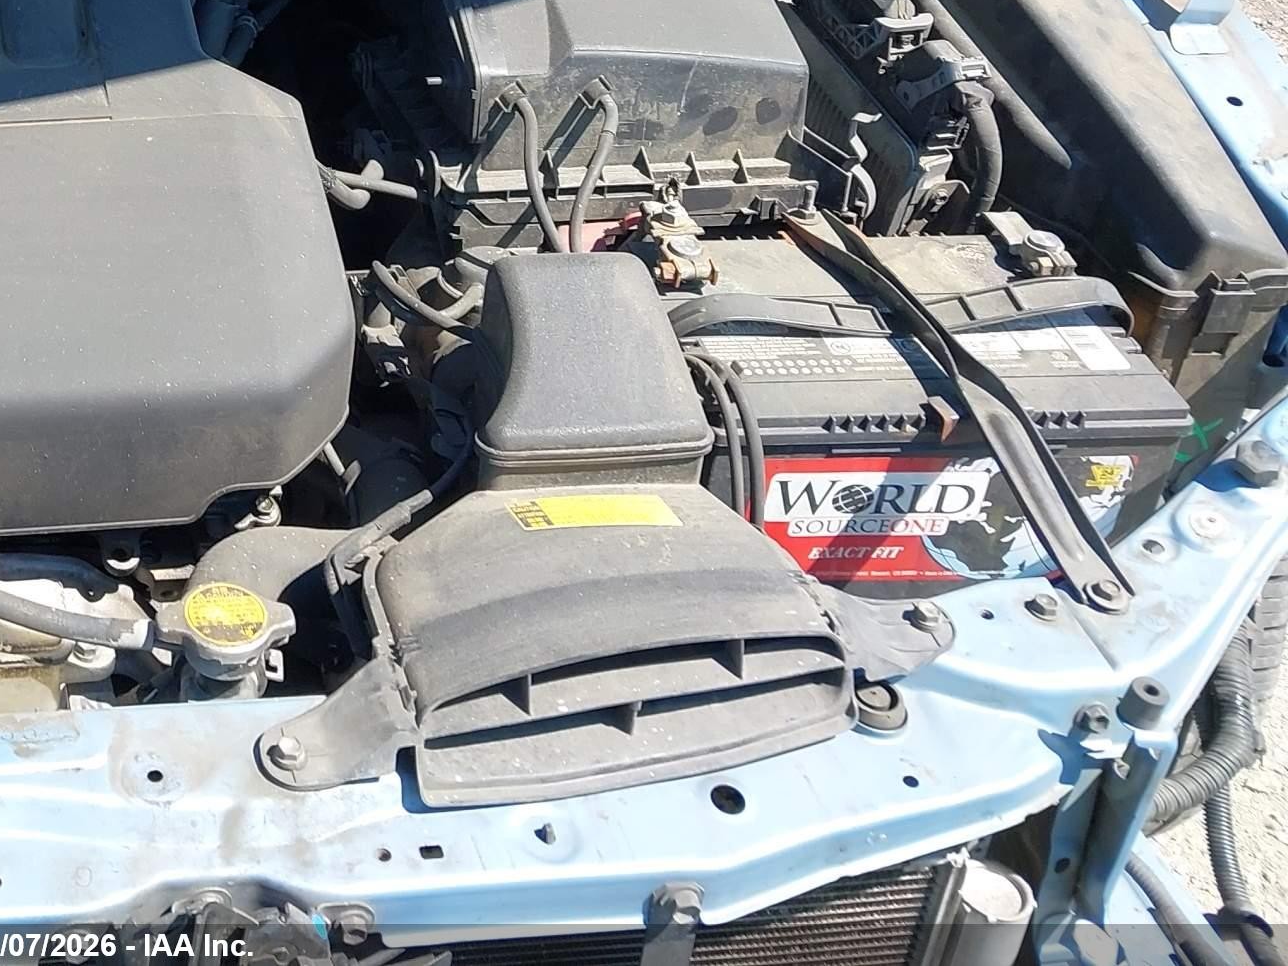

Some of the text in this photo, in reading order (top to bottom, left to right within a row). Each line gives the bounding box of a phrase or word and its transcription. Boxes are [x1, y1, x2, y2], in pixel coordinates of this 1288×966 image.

[775, 479, 977, 516] WORLD
[791, 517, 944, 534] SOURCEONE
[807, 545, 904, 560] EXACT FIT
